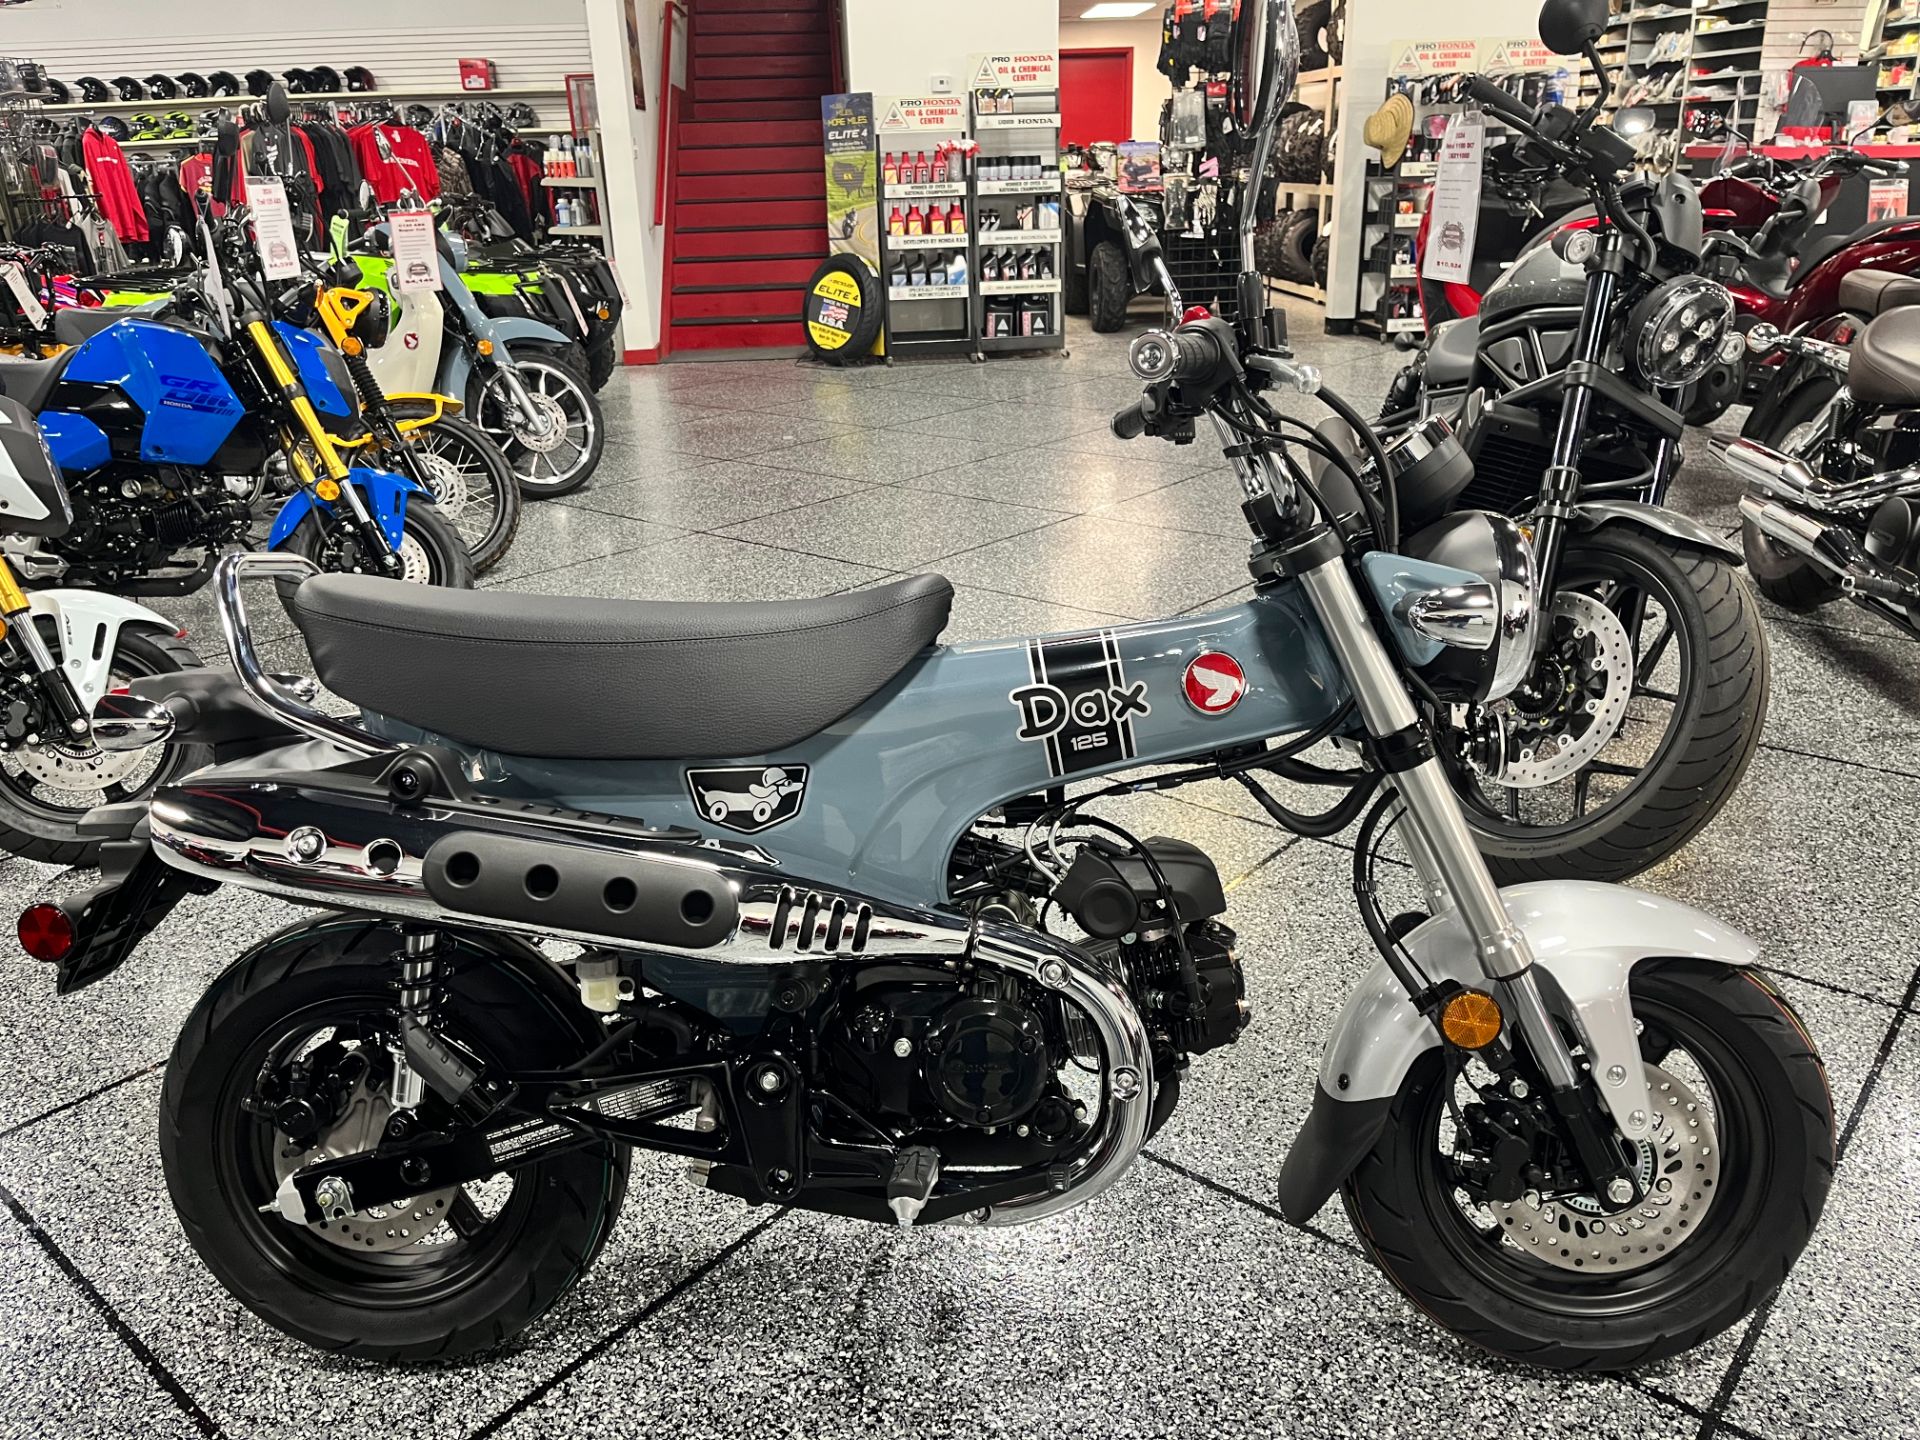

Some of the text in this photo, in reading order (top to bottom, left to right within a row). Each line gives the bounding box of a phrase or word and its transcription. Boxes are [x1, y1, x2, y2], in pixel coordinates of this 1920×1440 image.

[1438, 41, 1475, 49] HONDA
[1440, 51, 1471, 59] CHEMICAL
[1018, 65, 1051, 73] CHEMICAL
[926, 108, 958, 116] CHEMICAL
[828, 118, 846, 126] MORE
[920, 117, 944, 125] CENTER
[828, 128, 868, 140] ELITE 4
[819, 285, 851, 299] ELITE
[819, 314, 844, 330] USA
[163, 400, 193, 409] HONDA
[1009, 680, 1151, 742] Dax
[1070, 732, 1108, 751] 125
